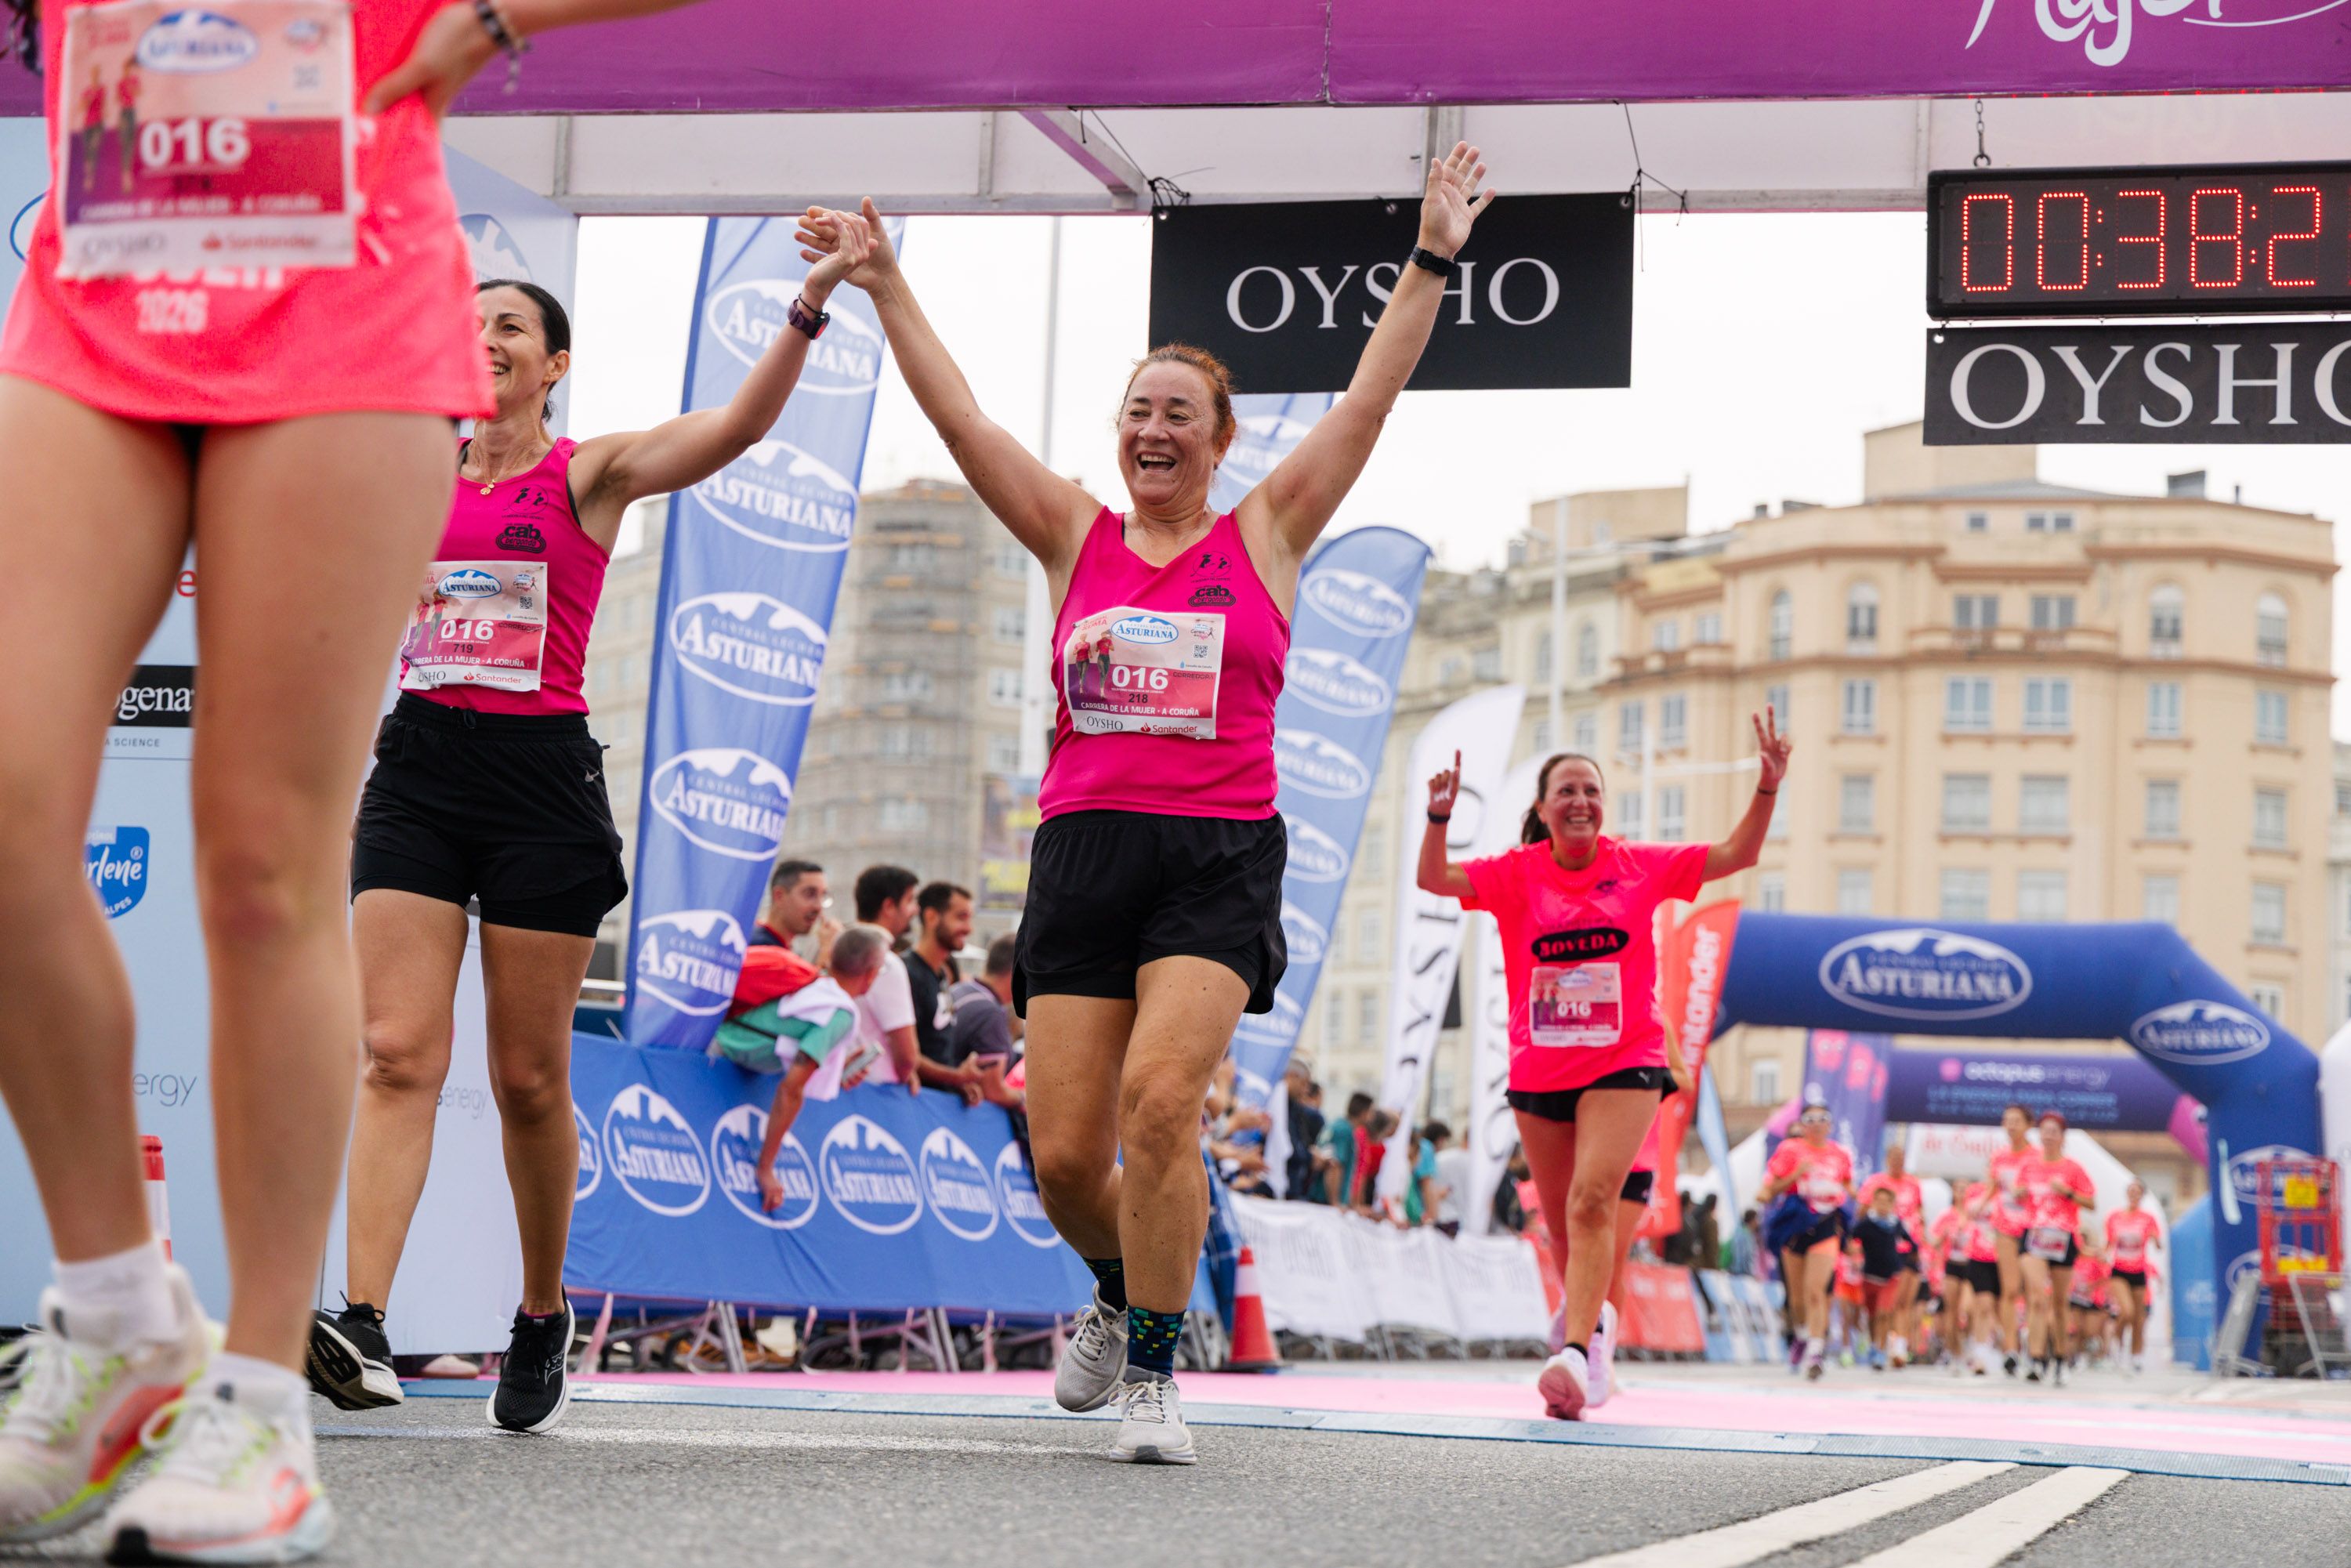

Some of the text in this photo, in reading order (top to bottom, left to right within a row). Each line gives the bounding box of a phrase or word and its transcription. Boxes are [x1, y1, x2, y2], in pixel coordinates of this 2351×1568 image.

[138, 118, 252, 167] 016
[1962, 186, 2321, 292] 00:38:2
[723, 298, 875, 382] ASTIANA
[701, 469, 853, 537] ASTURIANA
[504, 523, 541, 539] cab
[442, 579, 498, 592] ASTURIANA
[1195, 585, 1230, 597] cab
[440, 619, 494, 640] 016
[1115, 623, 1174, 639] ASTURIANA
[453, 643, 473, 653] 719
[455, 655, 480, 664] MUJER
[494, 656, 525, 668] CORUÑA
[476, 673, 522, 684] Santander
[1111, 665, 1169, 690] 016
[1128, 693, 1148, 703] 218
[1081, 701, 1109, 712] CARRERA
[1120, 704, 1130, 713] LA
[1131, 706, 1155, 715] MUJER
[1168, 707, 1200, 716] CORUÑA
[1086, 715, 1198, 733] OYSHO Santander
[114, 738, 160, 748] SCIENCE
[103, 896, 132, 915] ALPES
[1838, 954, 2016, 1002] ASTURIANA
[1557, 1001, 1592, 1018] 016
[612, 1125, 705, 1186] ASTURIANA
[829, 1155, 917, 1205] ASTURIANA
